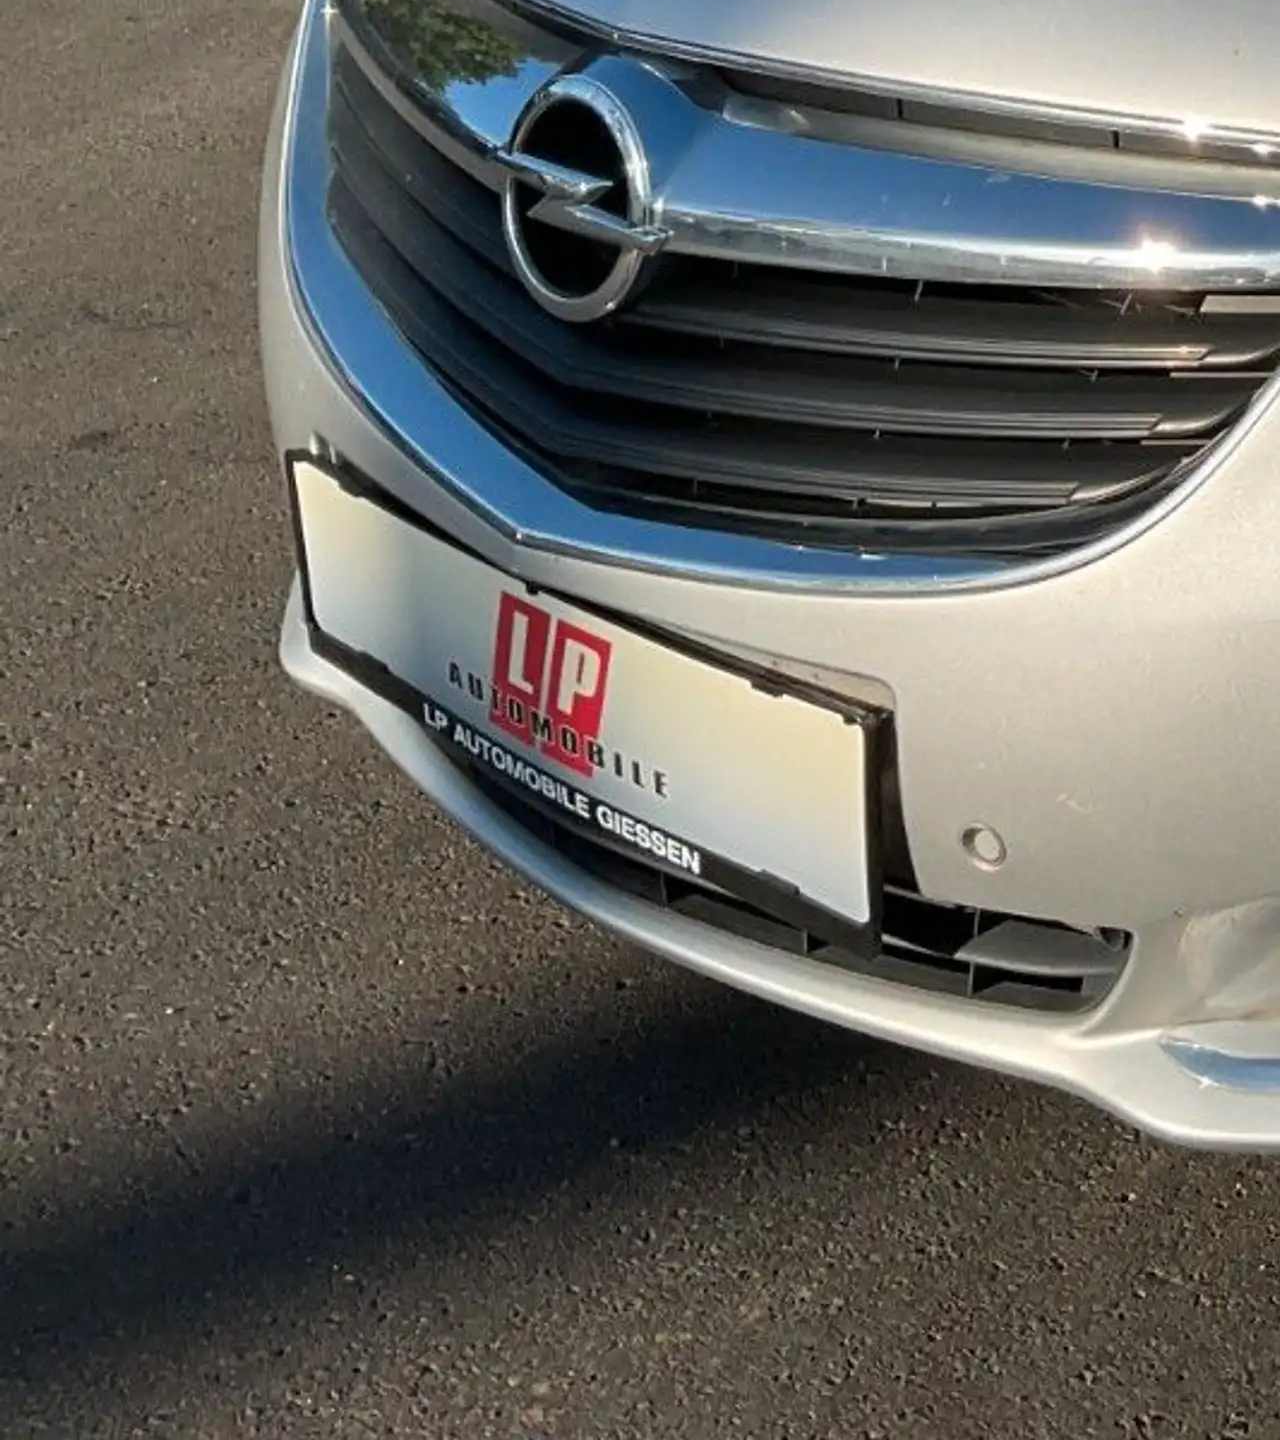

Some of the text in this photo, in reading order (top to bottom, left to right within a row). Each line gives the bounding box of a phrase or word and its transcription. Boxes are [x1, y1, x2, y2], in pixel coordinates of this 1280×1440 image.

[448, 661, 670, 799] AUTOMOBILE
[507, 611, 602, 715] LP
[423, 702, 701, 876] LP AUTOMOBILE GIESSEN
